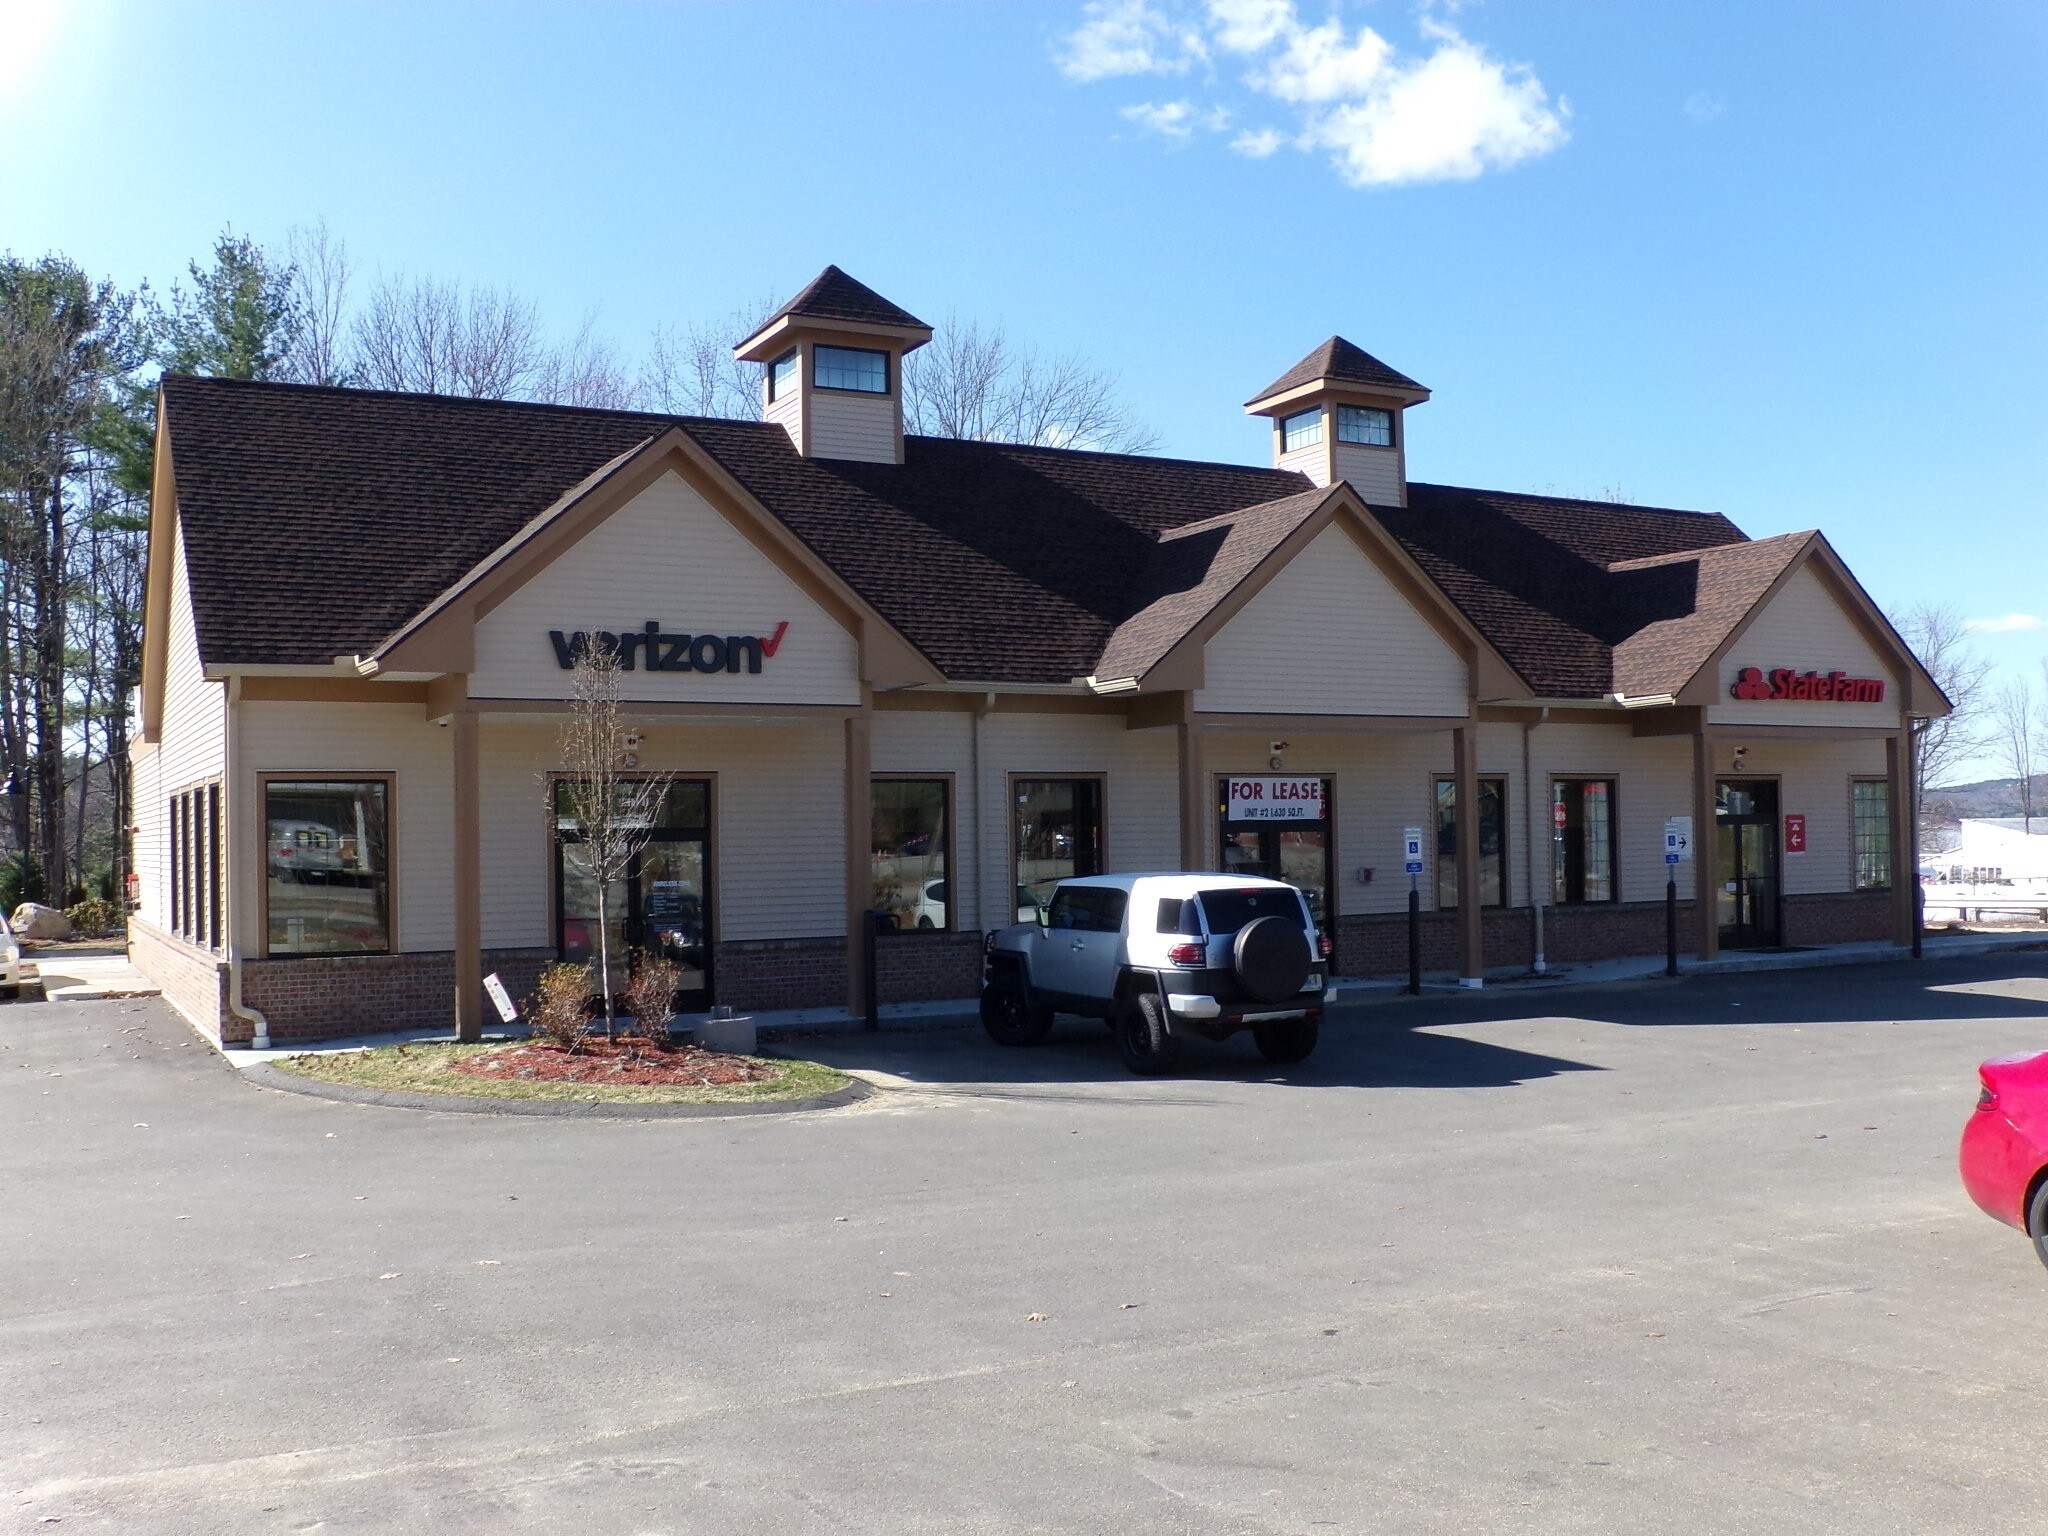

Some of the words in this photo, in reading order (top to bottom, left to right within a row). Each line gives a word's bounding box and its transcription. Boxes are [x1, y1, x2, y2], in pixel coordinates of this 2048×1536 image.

[549, 620, 762, 674] verizon
[1231, 782, 1263, 800] FOR
[1272, 782, 1319, 800] LEASE
[1244, 807, 1258, 817] UNIT
